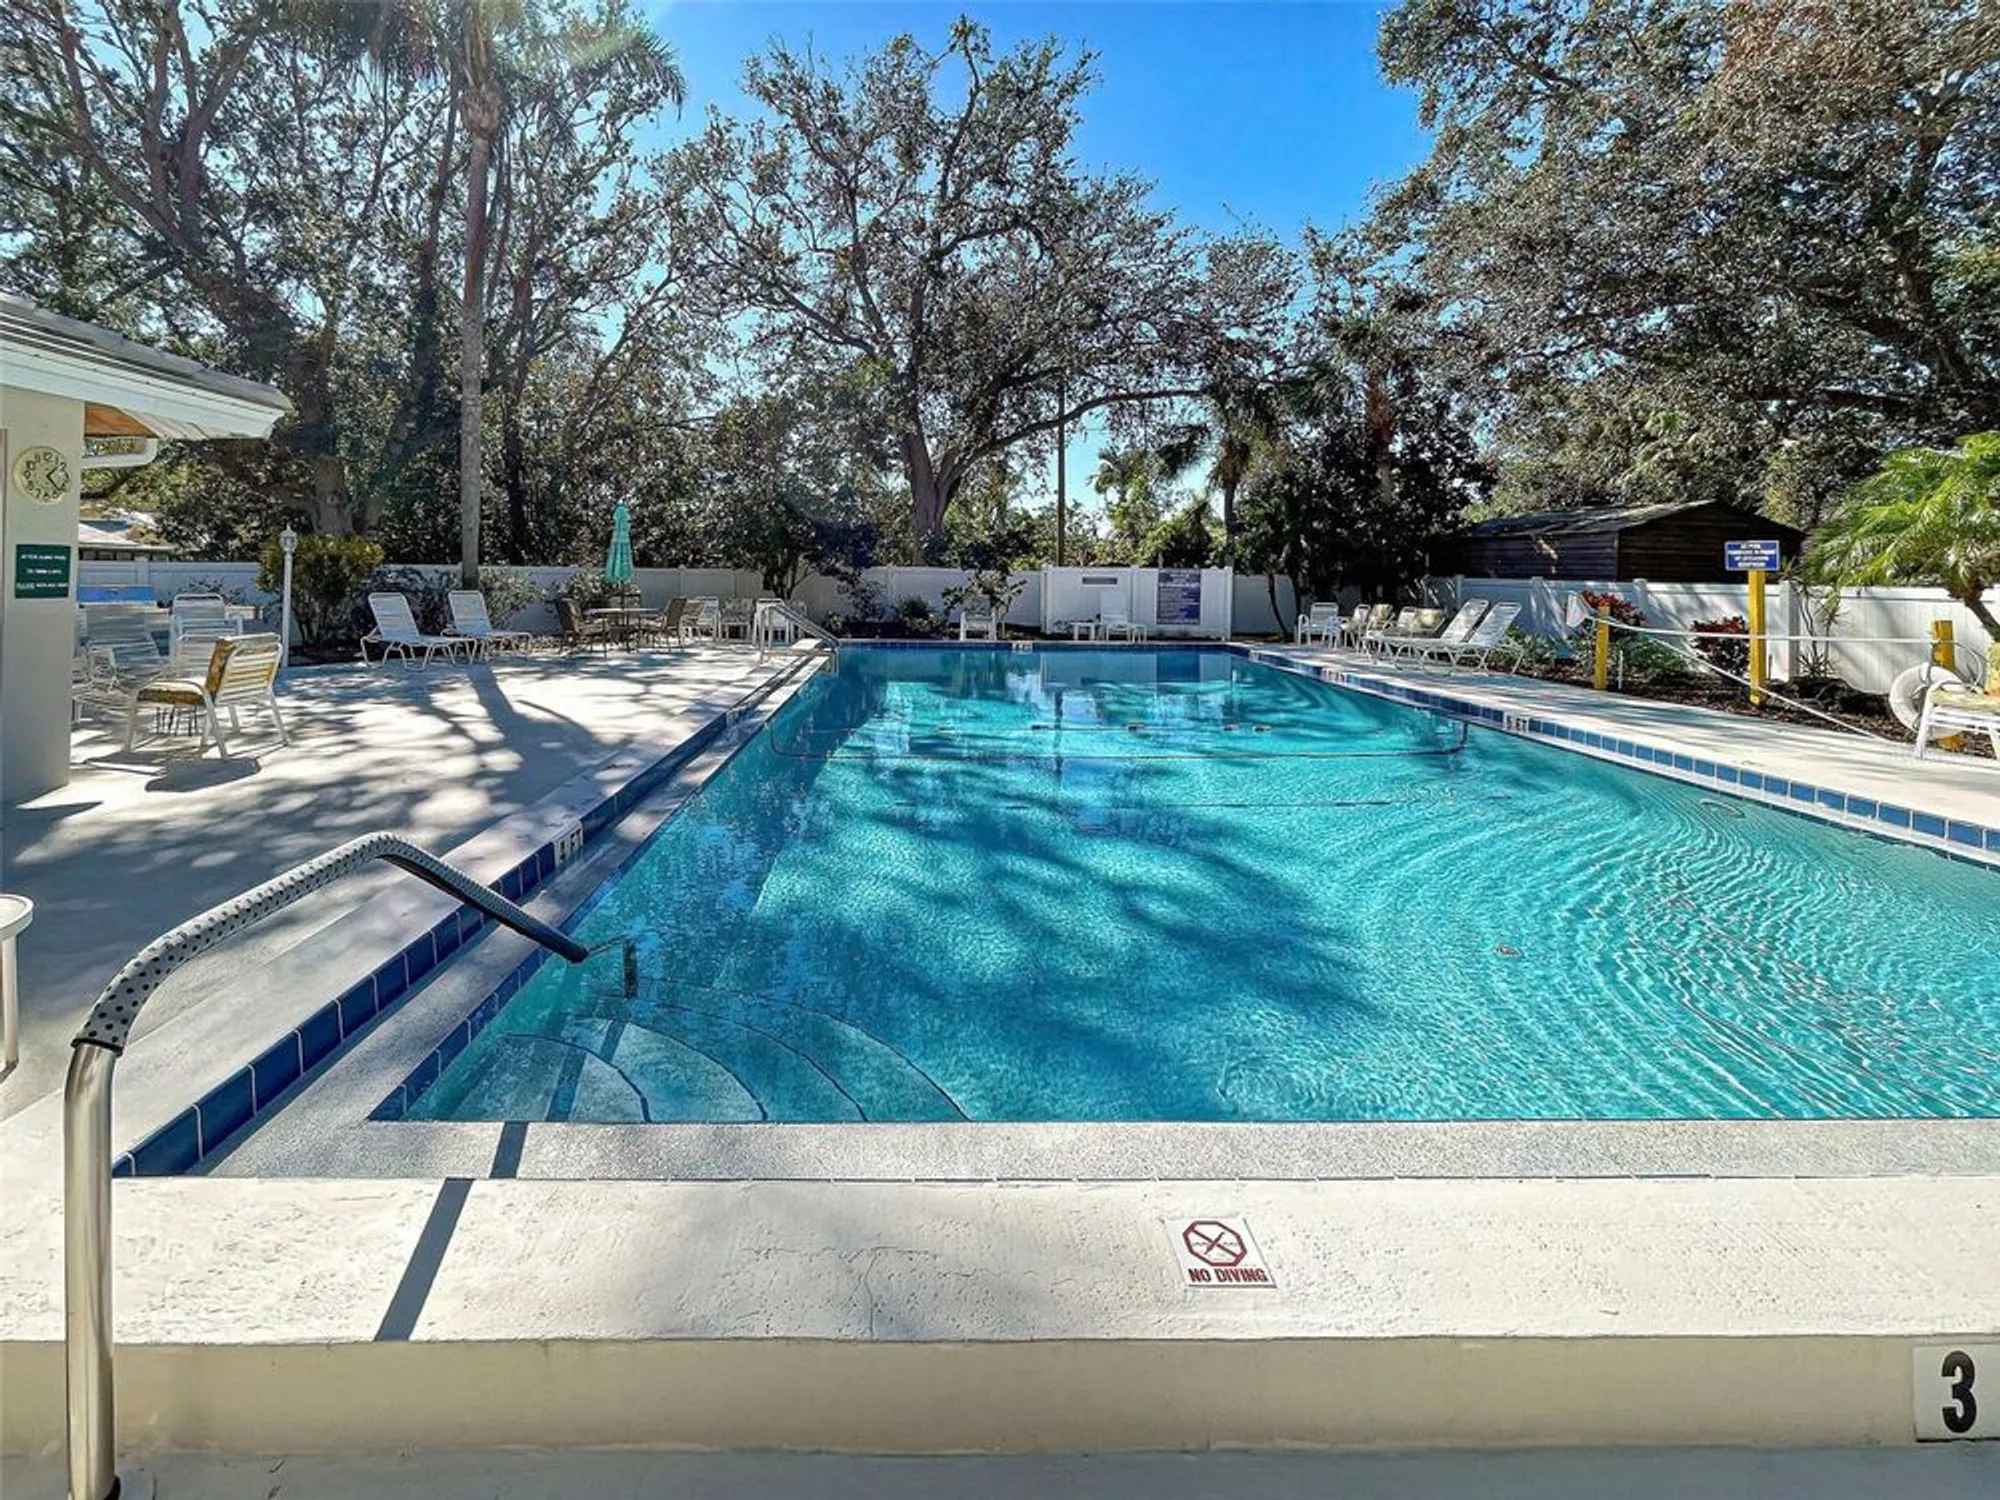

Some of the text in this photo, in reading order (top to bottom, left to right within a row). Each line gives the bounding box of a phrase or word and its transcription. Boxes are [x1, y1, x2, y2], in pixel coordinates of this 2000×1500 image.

[60, 462, 67, 471] 2
[35, 488, 41, 499] 7
[1188, 1268, 1269, 1283] NO DIVING
[1941, 1350, 1977, 1434] 3
